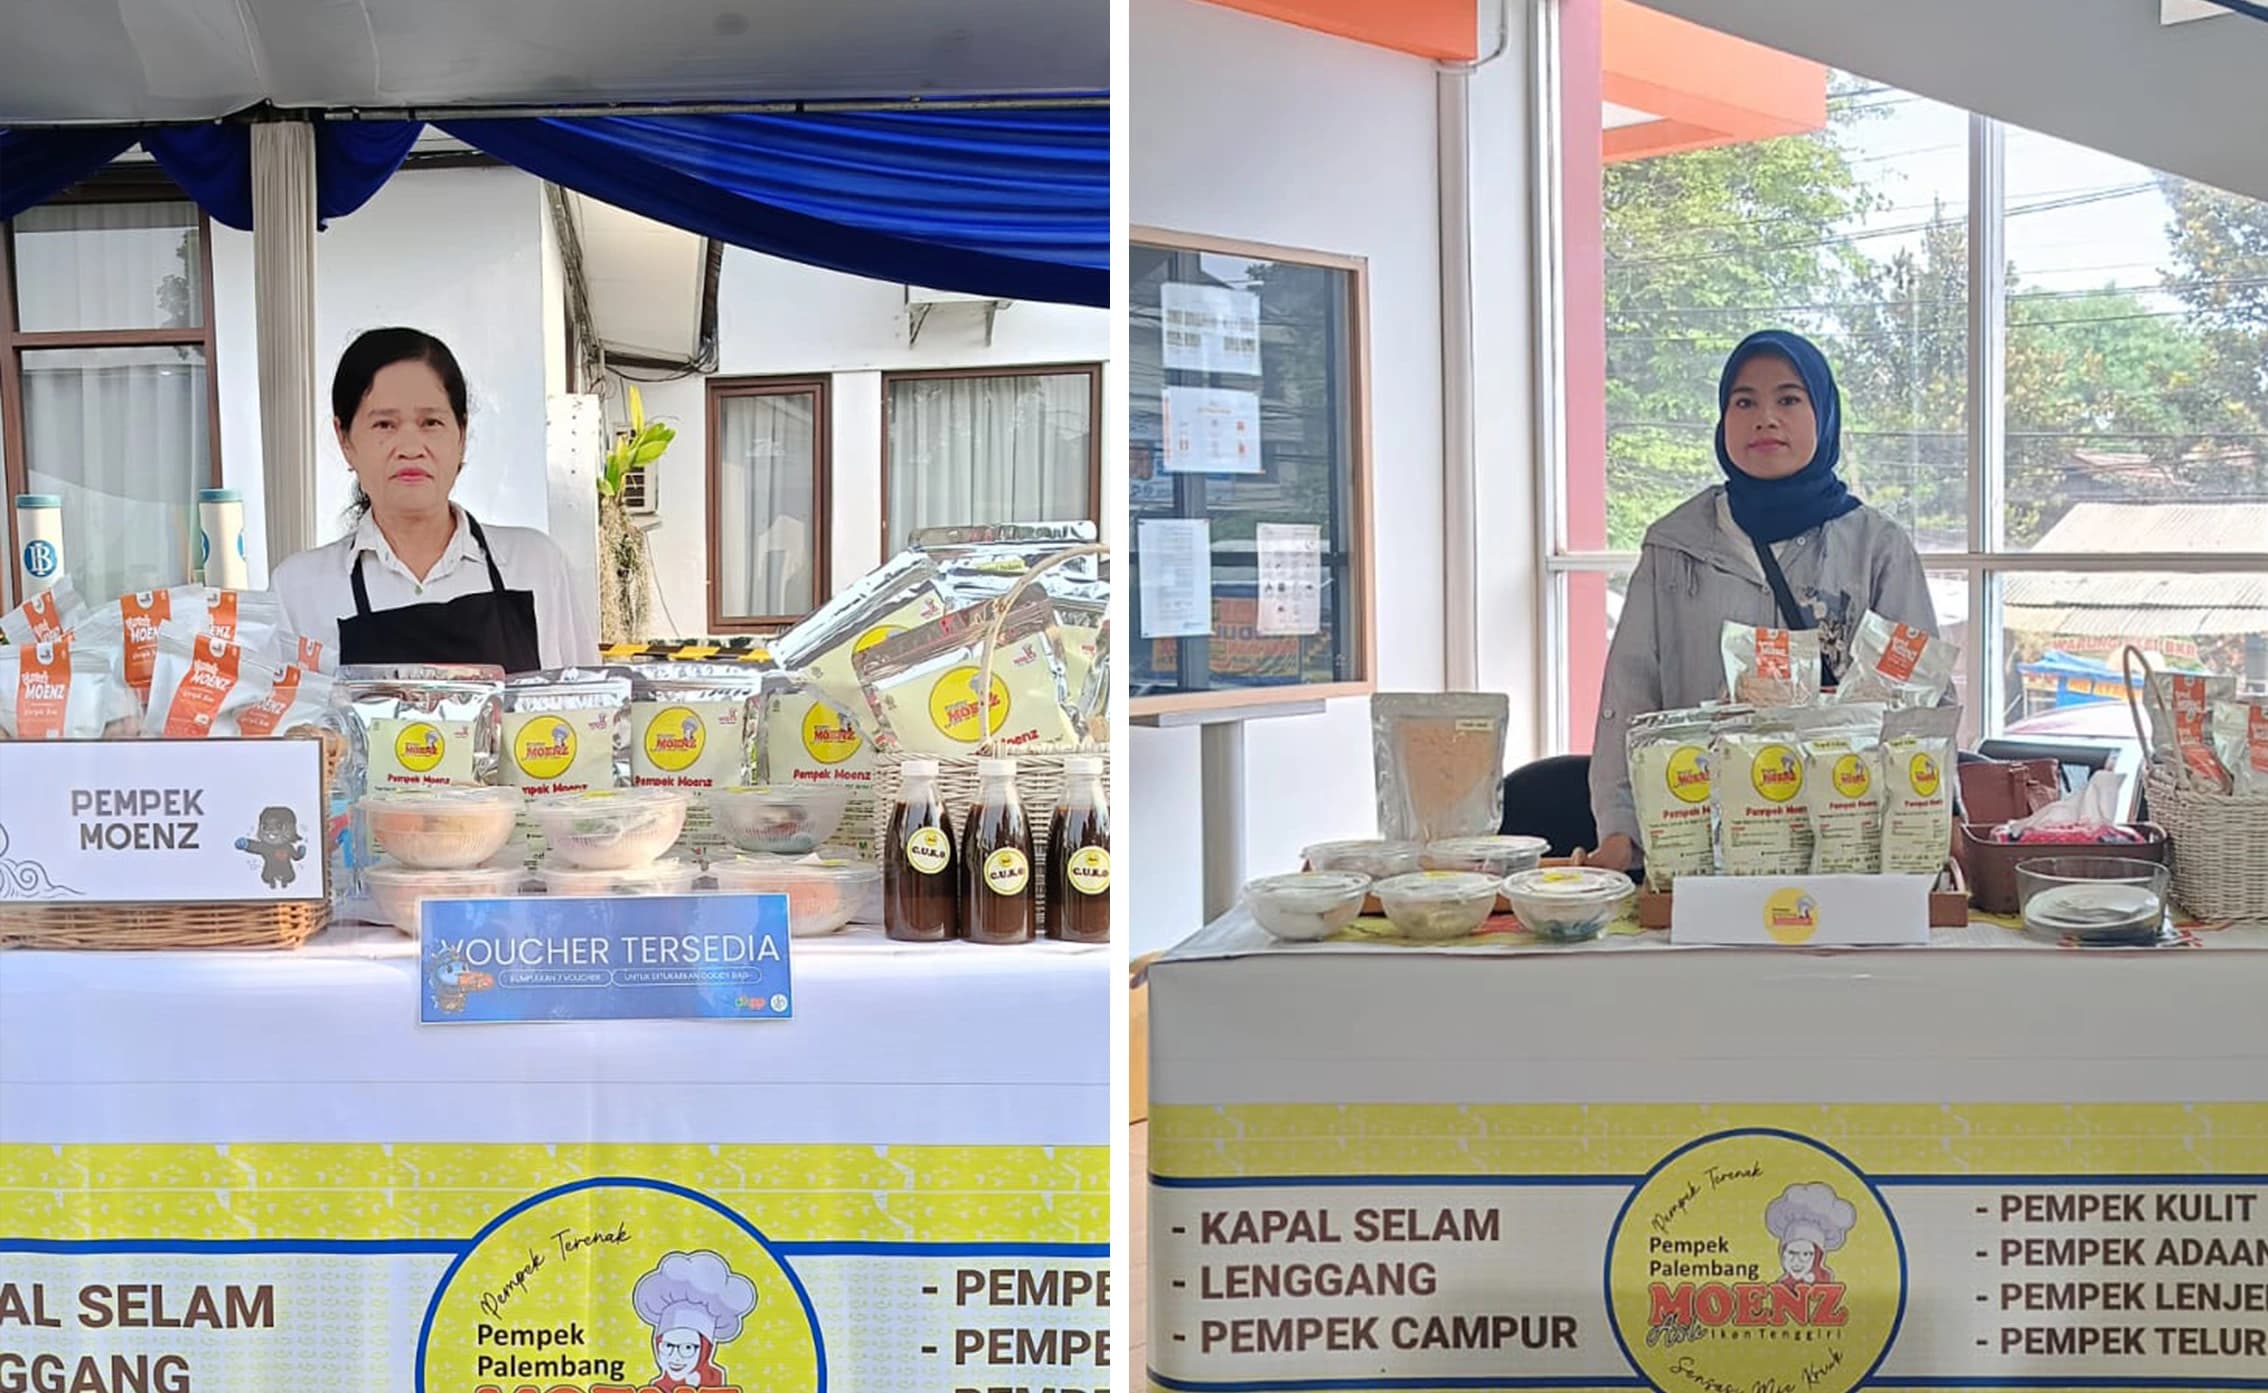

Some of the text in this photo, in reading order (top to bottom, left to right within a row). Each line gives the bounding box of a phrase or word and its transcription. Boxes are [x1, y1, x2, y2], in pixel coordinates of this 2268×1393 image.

[130, 626, 160, 645] MOEN
[24, 683, 66, 700] MOENZ
[793, 769, 871, 782] Pempek Moenz
[72, 789, 204, 817] PEMPEK
[80, 822, 200, 850] MOENZ
[441, 935, 780, 966] VOUCHER TERSEDIA
[1651, 1181, 1700, 1234] Pempek
[2000, 1193, 2257, 1222] PEMPEK KULIT
[1201, 1208, 1500, 1245] KAPAL SELAM
[1649, 1236, 1729, 1256] Pempek
[2000, 1238, 2146, 1266] PEMPEK
[480, 1222, 632, 1321] Pempek Terenak
[1201, 1262, 1437, 1299] LENGGANG
[1649, 1260, 1760, 1281] Palembang
[78, 1284, 274, 1329] SELAM
[1648, 1282, 1849, 1327] MOENZ
[2000, 1282, 2268, 1311] PEMPEK LENJE
[477, 1323, 585, 1351] Pempek
[1201, 1315, 1578, 1353] PEMPEK CAMPUR
[2000, 1327, 2268, 1356] PEMPEK TELUR
[477, 1355, 625, 1382] Palembang
